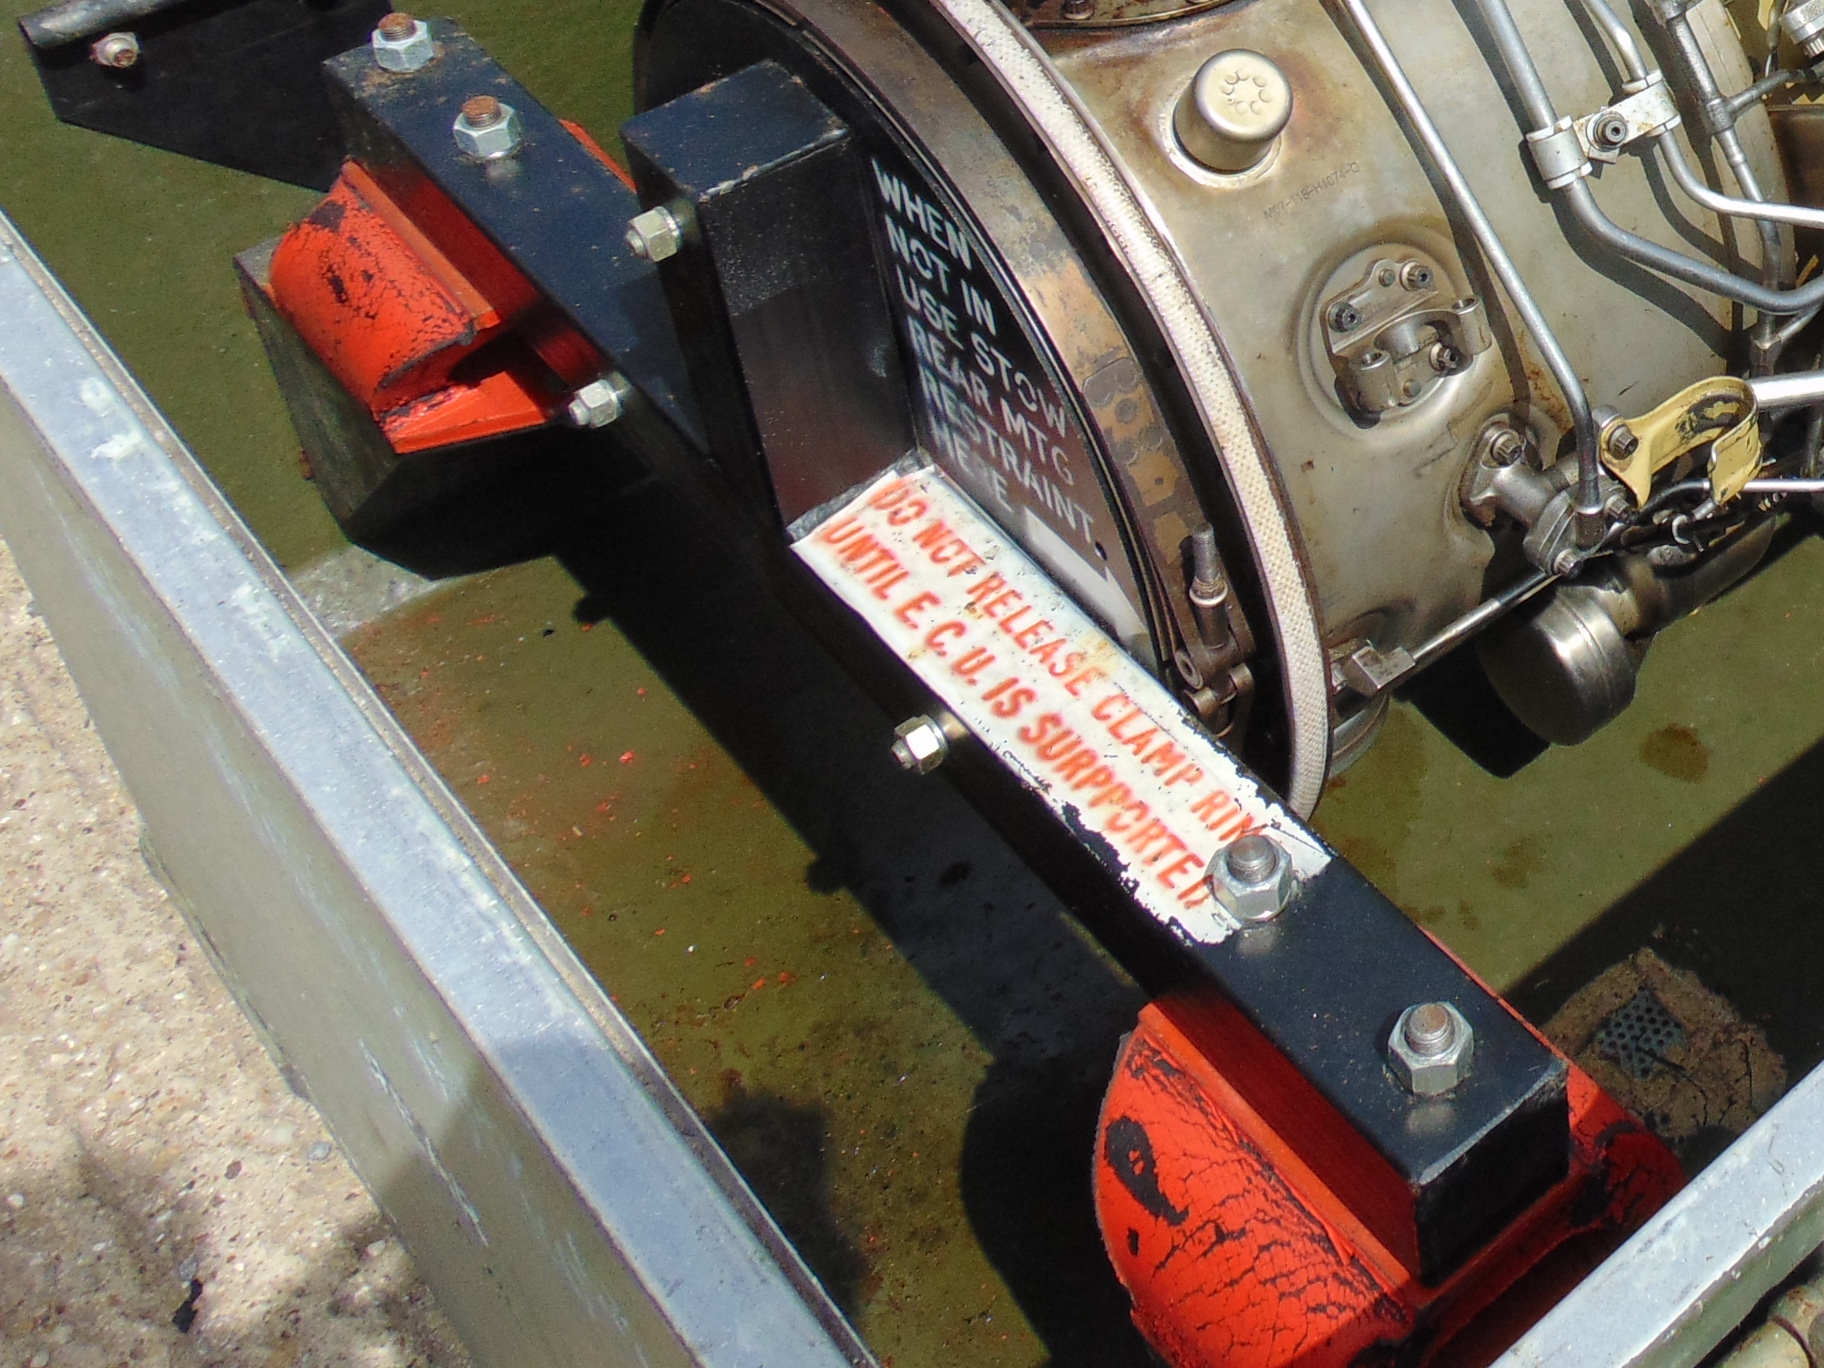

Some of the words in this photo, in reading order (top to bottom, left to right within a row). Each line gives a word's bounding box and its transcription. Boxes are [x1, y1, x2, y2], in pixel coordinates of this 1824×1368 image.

[871, 156, 973, 270] WHEN
[884, 214, 950, 295] NOT
[960, 278, 997, 336] IN
[896, 264, 965, 351] USE
[971, 332, 1067, 438] STOW
[907, 315, 993, 416] REAR
[1001, 397, 1075, 486] MTG
[919, 363, 1095, 544] RESTRAINT
[929, 409, 1014, 513] HEE
[821, 514, 911, 601] UNTIL
[981, 675, 1038, 719] IS
[866, 477, 929, 527] DO
[912, 519, 987, 578] NOT
[966, 570, 1110, 697] RELEASE
[1091, 692, 1205, 787] CLAMP
[1190, 789, 1264, 842] RIN
